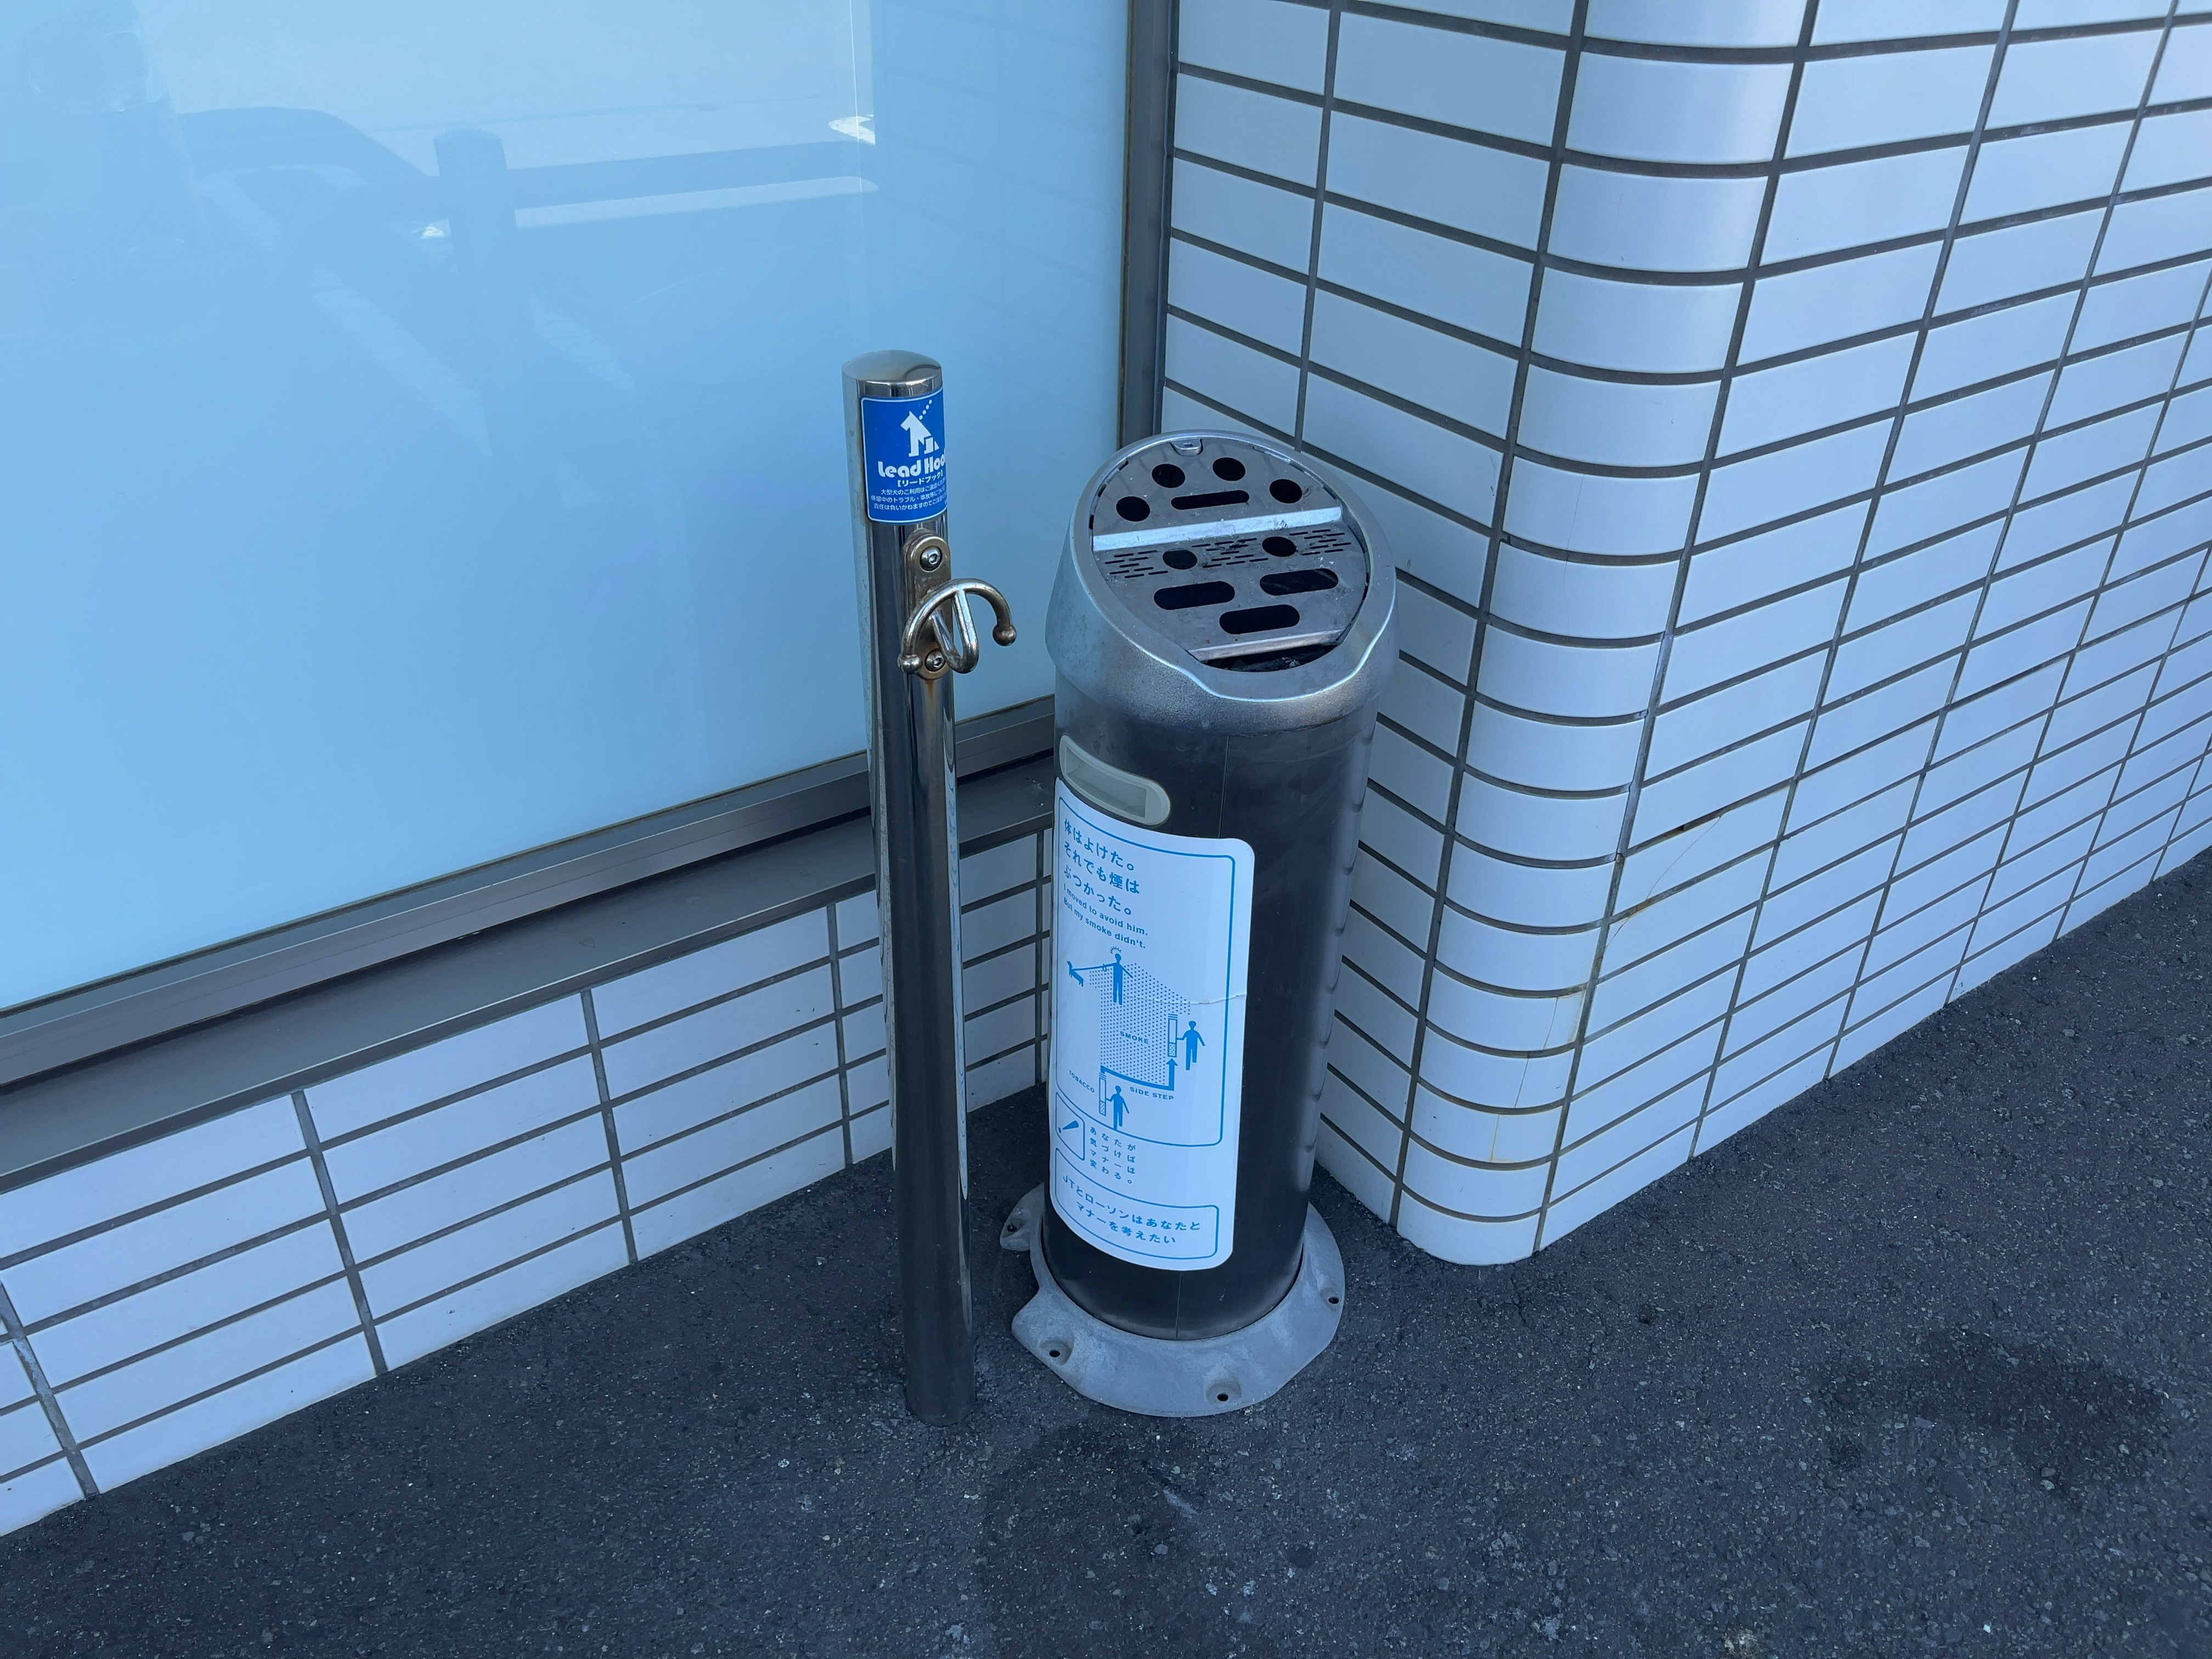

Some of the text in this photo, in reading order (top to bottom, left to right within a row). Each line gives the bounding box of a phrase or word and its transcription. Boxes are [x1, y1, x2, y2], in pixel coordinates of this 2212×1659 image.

[878, 449, 946, 478] Lead Hoo
[1064, 818, 1134, 871] 体はよけた。
[1064, 840, 1139, 894] それでも煙は
[1064, 865, 1131, 915] ぶつかった。
[1067, 888, 1087, 909] moved
[1090, 906, 1097, 915] to
[1099, 912, 1123, 928] avoid
[1127, 923, 1148, 936] him.
[1064, 897, 1146, 949] But my smoke didn't.
[1120, 1031, 1149, 1044] SMOKE
[1069, 1070, 1095, 1093] TOBACCO
[1130, 1087, 1174, 1101] SIDE STEP
[1063, 1175, 1200, 1231] JTとローソンはあなたと
[1076, 1201, 1176, 1244] マナーを考えたい
